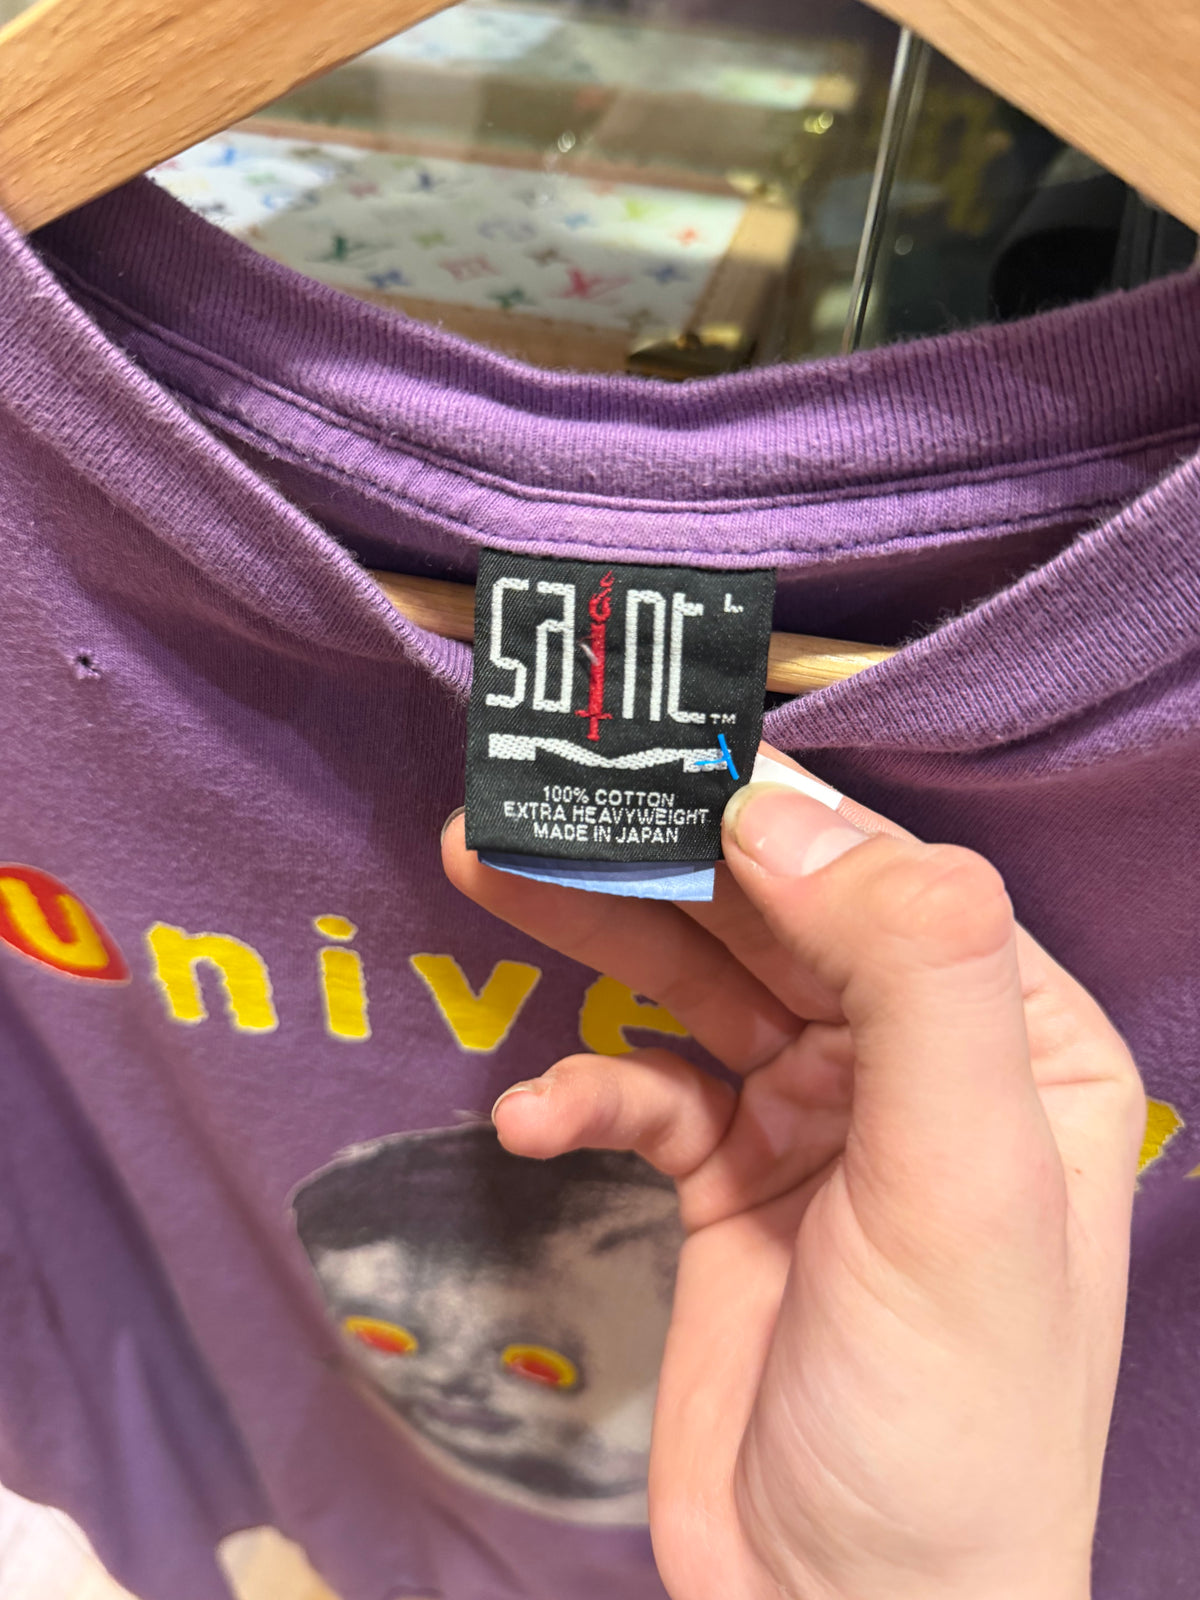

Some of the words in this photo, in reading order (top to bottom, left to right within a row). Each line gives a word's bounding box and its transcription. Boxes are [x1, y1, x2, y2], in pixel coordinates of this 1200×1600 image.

[723, 592, 744, 613] L
[543, 785, 590, 805] 100%
[595, 788, 675, 808] COTTON
[503, 800, 567, 822] EXTRA
[572, 805, 710, 826] HEAVYWEIGHT
[533, 822, 589, 842] MADE
[593, 825, 612, 843] IN
[615, 826, 679, 844] JAPAN
